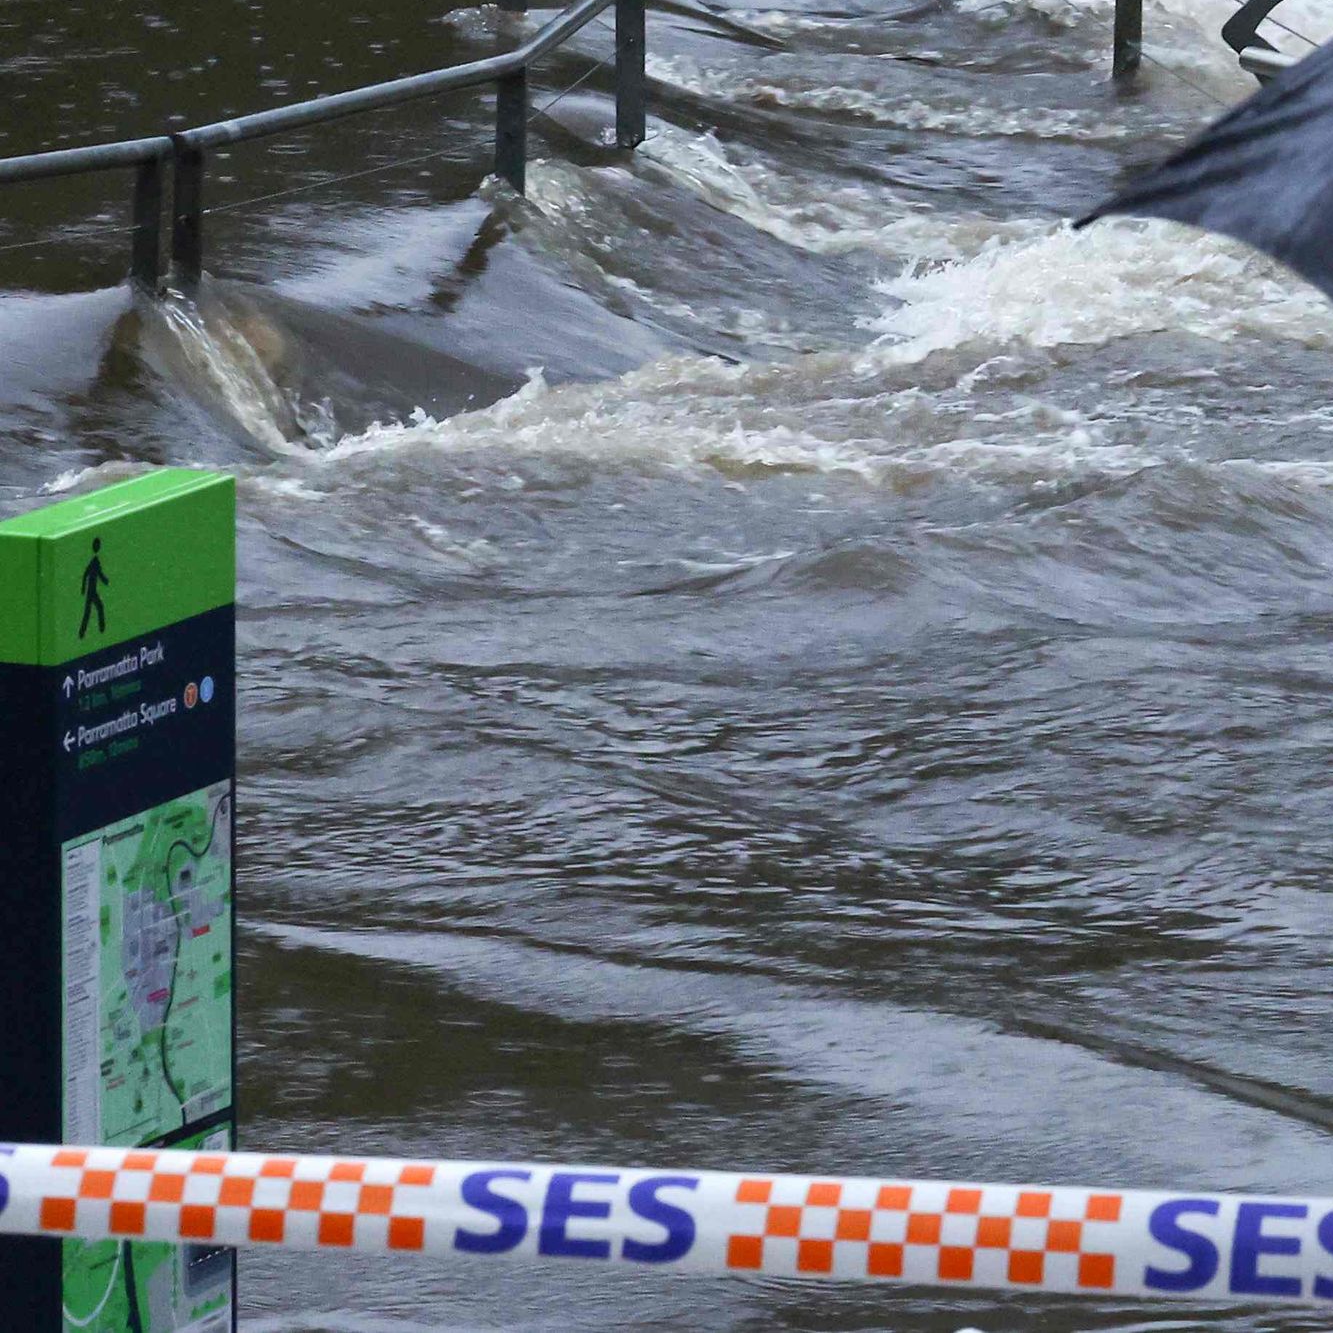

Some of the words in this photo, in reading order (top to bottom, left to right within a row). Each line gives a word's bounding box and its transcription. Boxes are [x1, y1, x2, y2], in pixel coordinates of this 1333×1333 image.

[78, 654, 138, 690] Parramatta
[140, 641, 164, 669] Park
[78, 710, 138, 747] Parramatta
[140, 698, 177, 725] Square
[454, 1168, 700, 1265] SES
